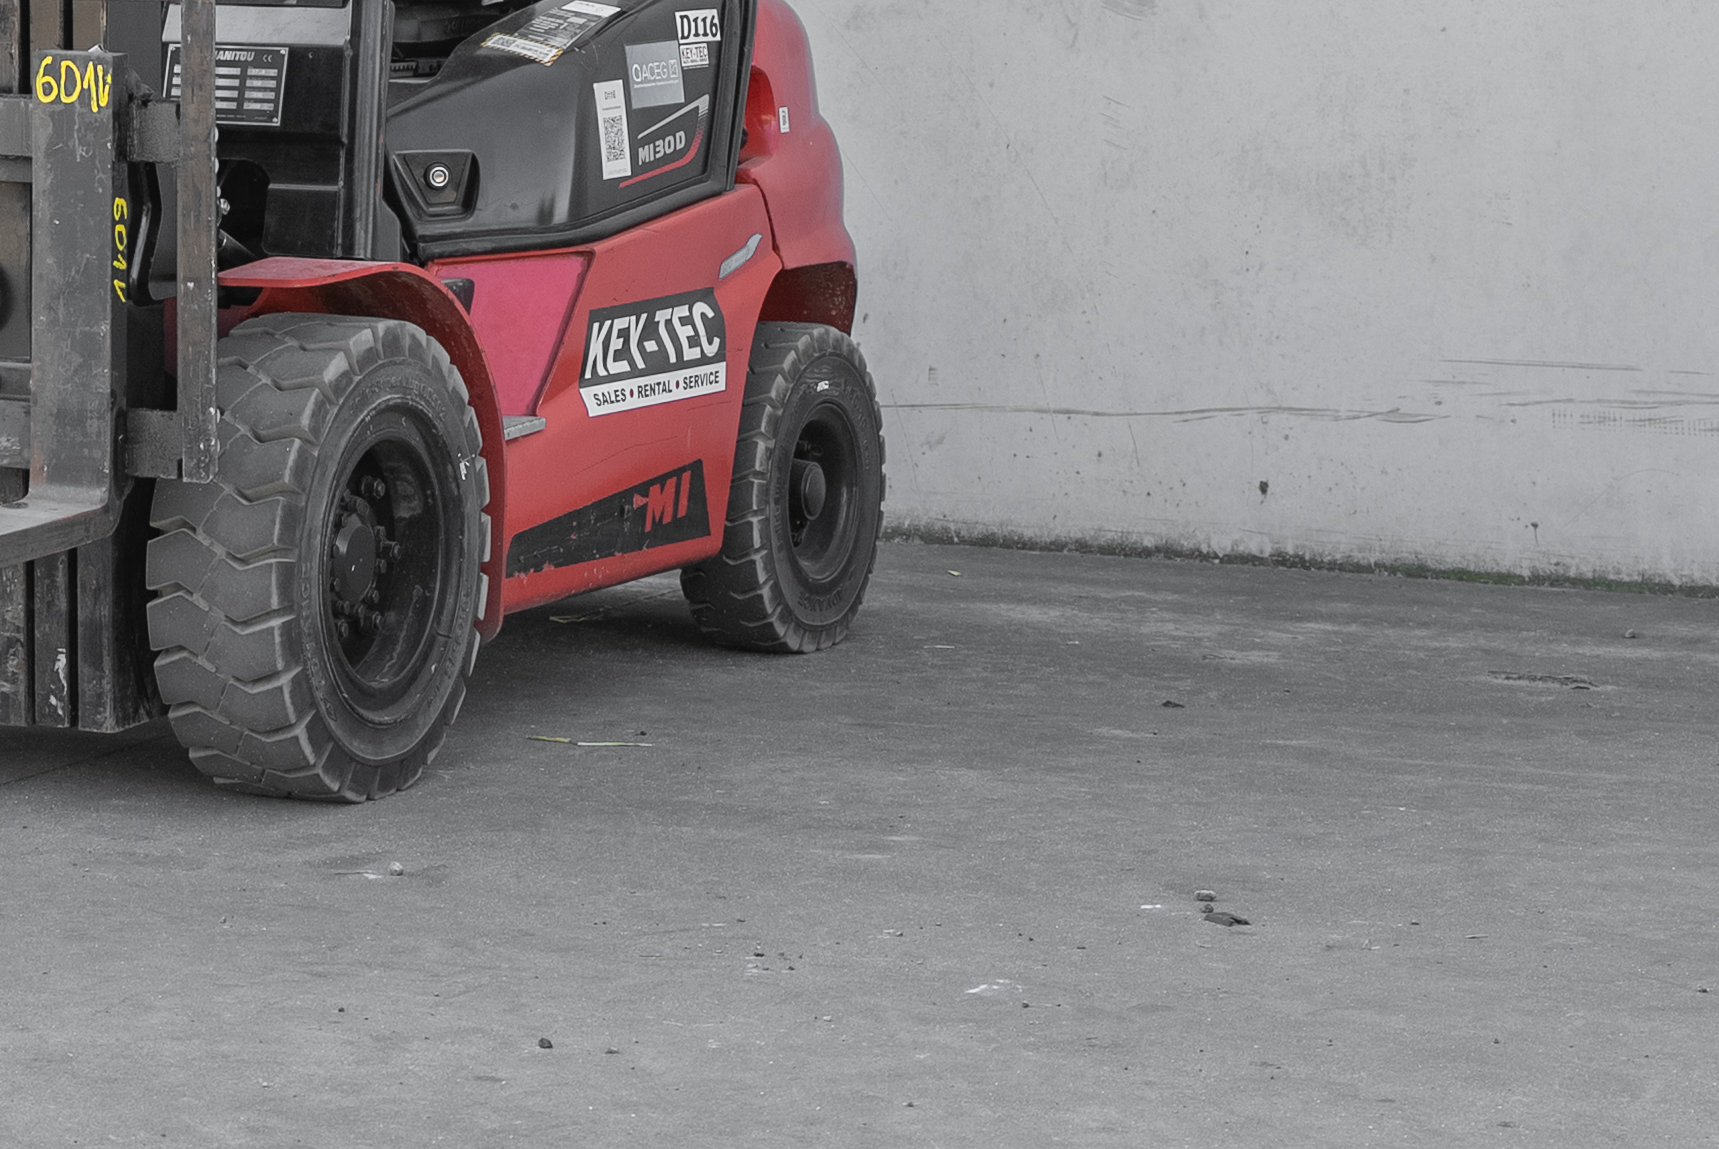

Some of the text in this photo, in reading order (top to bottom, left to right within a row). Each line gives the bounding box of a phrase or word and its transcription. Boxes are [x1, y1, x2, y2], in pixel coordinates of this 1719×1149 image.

[679, 14, 718, 40] D116
[215, 50, 255, 62] ANITOU
[681, 45, 708, 60] KEY-TEC
[584, 301, 721, 380] KEY-TEC
[593, 370, 720, 407] SALES RENTAL SERVICE
